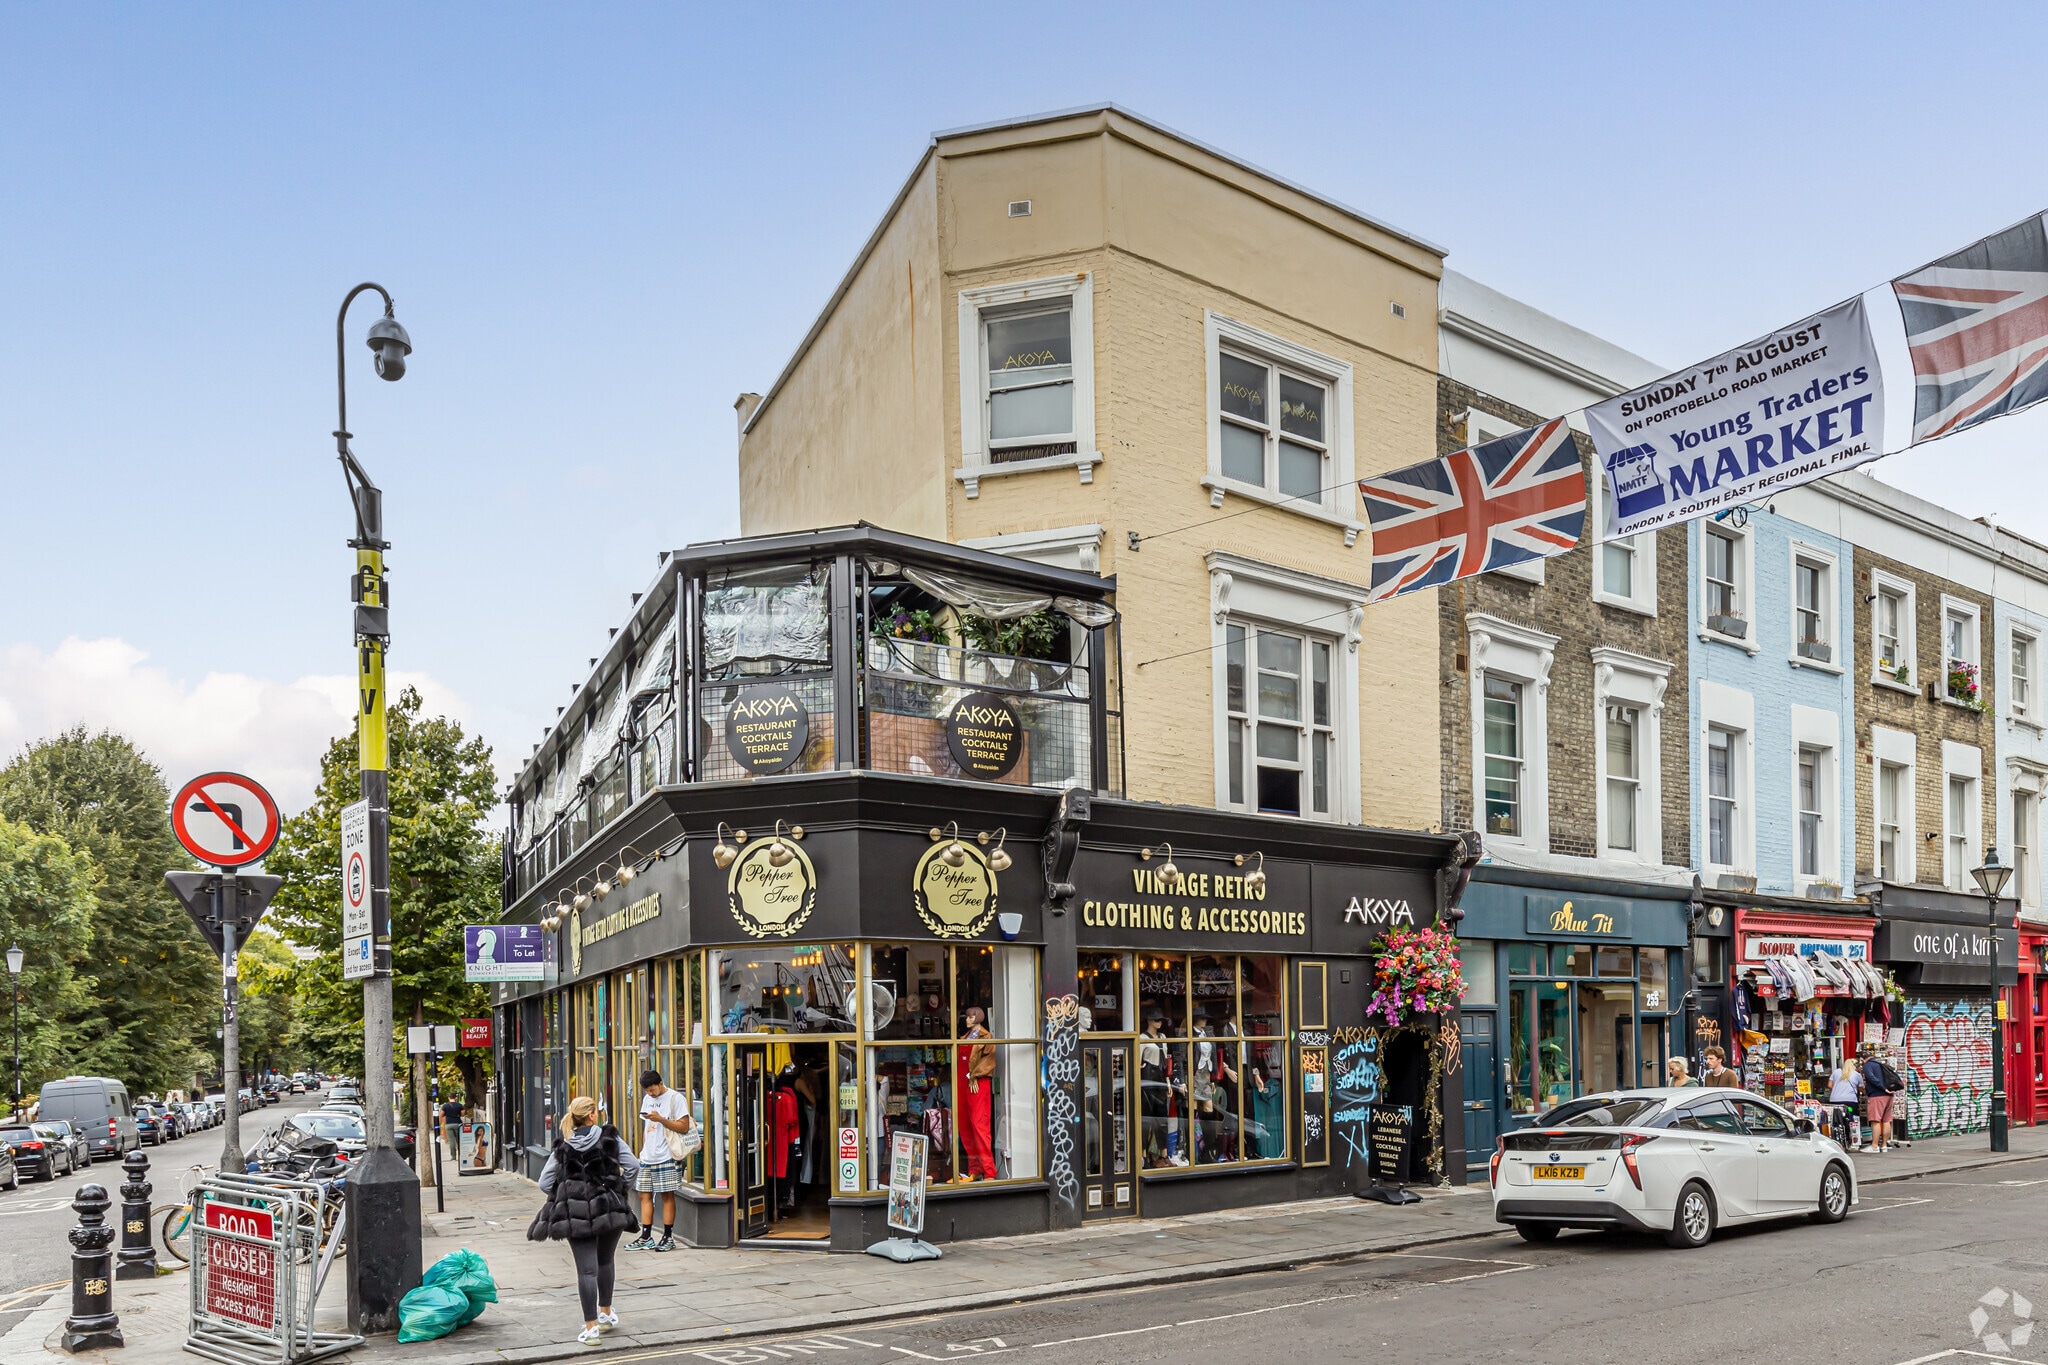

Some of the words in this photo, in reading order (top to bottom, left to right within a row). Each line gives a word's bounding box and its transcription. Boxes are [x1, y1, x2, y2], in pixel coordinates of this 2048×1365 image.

[1002, 350, 1056, 371] AKOYA
[1620, 375, 1698, 417] SUNDAY
[1704, 364, 1729, 385] 7th
[1735, 323, 1823, 373] AUGUST
[1224, 381, 1261, 403] AKOYA
[1625, 421, 1642, 434] ON
[1645, 387, 1728, 430] PORTOBELLO
[1731, 373, 1768, 394] ROAD
[1771, 346, 1829, 377] MARKET
[1670, 411, 1753, 452] Young
[1758, 366, 1869, 421] Traders
[1669, 393, 1873, 502] MARKET
[1617, 514, 1663, 535] LONDON
[1668, 511, 1675, 519] &
[1679, 495, 1721, 516] SOUTH
[1724, 484, 1755, 502] EAST
[1758, 458, 1827, 490] REGIONAL
[1831, 442, 1871, 464] FINAL
[1618, 476, 1648, 494] NMTF
[733, 696, 798, 721] AKOYA
[955, 704, 1015, 728] AKOYA
[736, 719, 797, 734] RESTAURANT
[957, 727, 1012, 741] RESTAURANT
[741, 732, 792, 744] COCKTAILS
[961, 738, 1008, 751] COCKTAILS
[746, 743, 789, 754] TERRACE
[967, 750, 1005, 761] TERRACE
[346, 829, 364, 849] ZONE
[745, 863, 793, 887] Pepper
[931, 864, 977, 890] Pepper
[763, 885, 799, 904] Tree
[948, 888, 983, 908] Tree
[629, 891, 660, 927] ACCESSORIES
[1083, 901, 1175, 930] CLOTHING
[1180, 906, 1193, 931] &
[1197, 907, 1305, 936] ACCESSORIES
[1344, 896, 1415, 926] AKOYA
[759, 923, 786, 932] LONDON
[943, 924, 970, 933] LONDON
[1550, 907, 1589, 933] Blue
[1591, 913, 1614, 934] Tit
[348, 946, 360, 957] Except
[1800, 943, 1843, 957] BRITANNIA
[1849, 945, 1865, 957] 257
[1913, 934, 1941, 954] one
[1944, 932, 1959, 960] of
[1961, 937, 1969, 955] a
[1972, 934, 1999, 956] kin
[1646, 993, 1659, 1007] 255
[1332, 1026, 1379, 1044] AKOYA
[1373, 1111, 1408, 1126] AKOYA
[1376, 1143, 1402, 1152] COCKTAILS
[1378, 1152, 1399, 1160] TERRACE
[1380, 1160, 1396, 1168] SHISHA
[1539, 1168, 1558, 1178] LK16
[1560, 1168, 1579, 1177] KZB
[219, 1213, 258, 1238] ROAD
[213, 1241, 268, 1276] CLOSED
[222, 1275, 257, 1298] Resident
[215, 1294, 243, 1313] access
[245, 1302, 265, 1322] only
